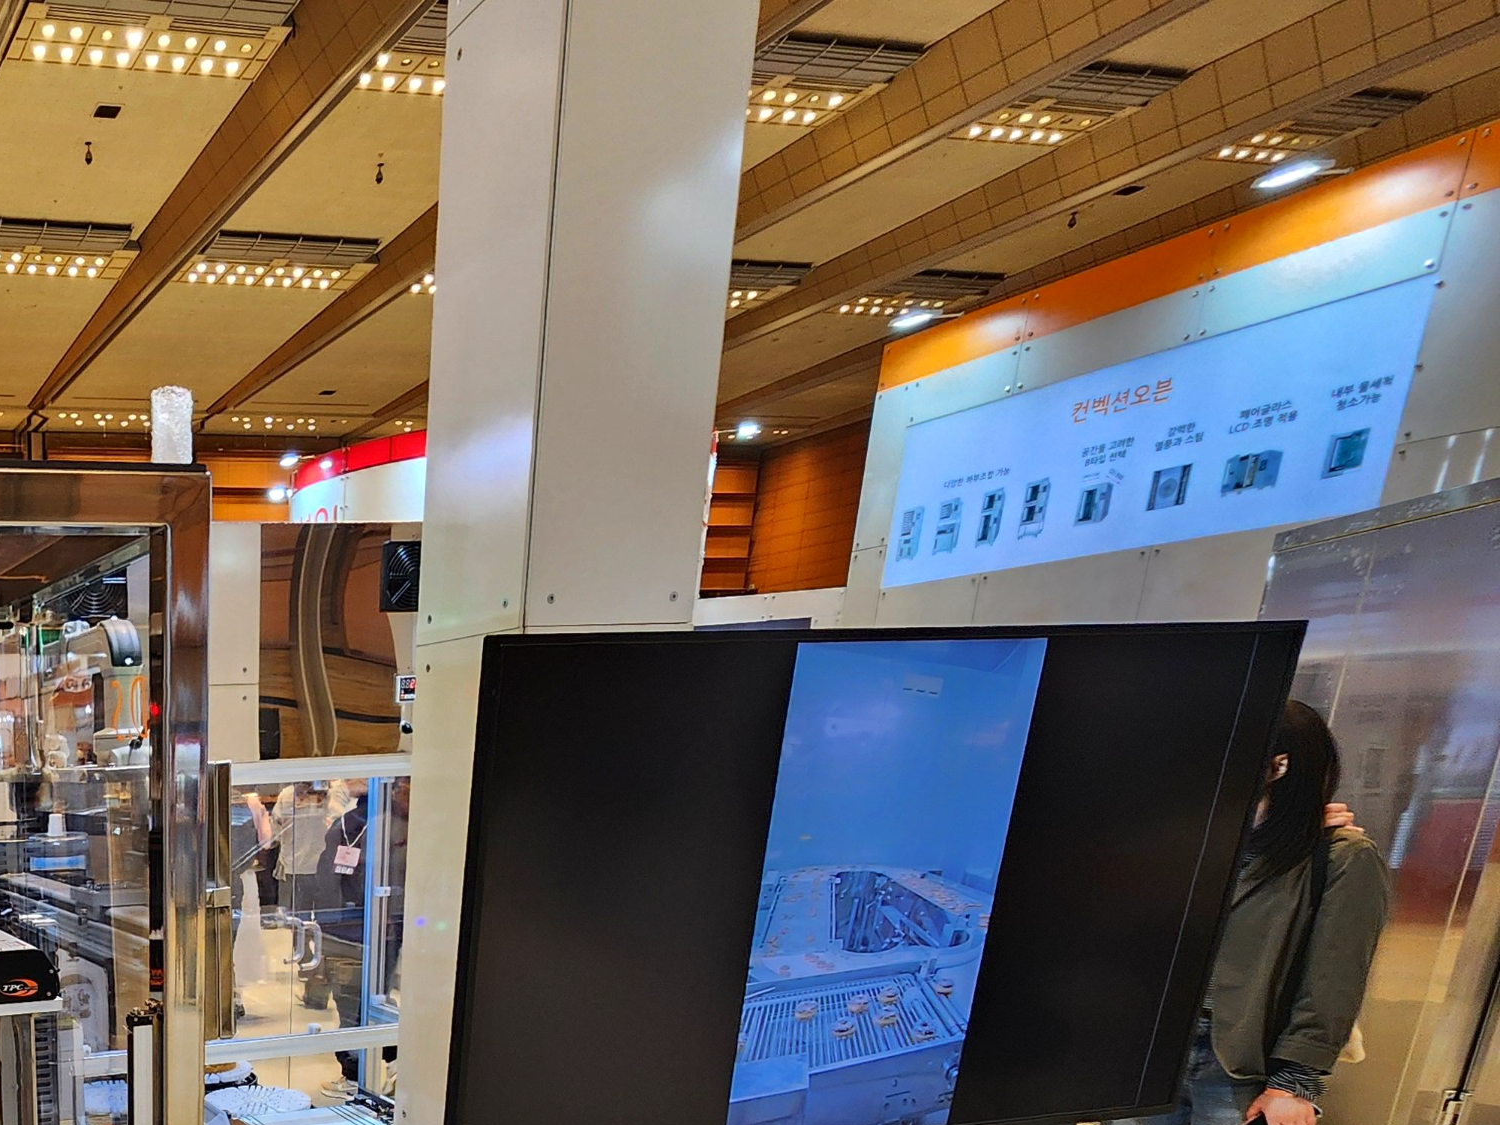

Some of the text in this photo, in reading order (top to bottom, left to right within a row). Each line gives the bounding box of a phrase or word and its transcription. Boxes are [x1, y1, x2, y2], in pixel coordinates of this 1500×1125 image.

[1071, 377, 1173, 424] 컨벡션오븐
[1331, 383, 1355, 398] 내부
[1239, 399, 1293, 419] 페어글라스
[1228, 409, 1298, 434] LCD 조명 적용
[1081, 436, 1135, 458] 공간을 고려한
[943, 477, 964, 489] 다양한
[995, 467, 1011, 477] 가능
[2, 984, 25, 992] TPC
